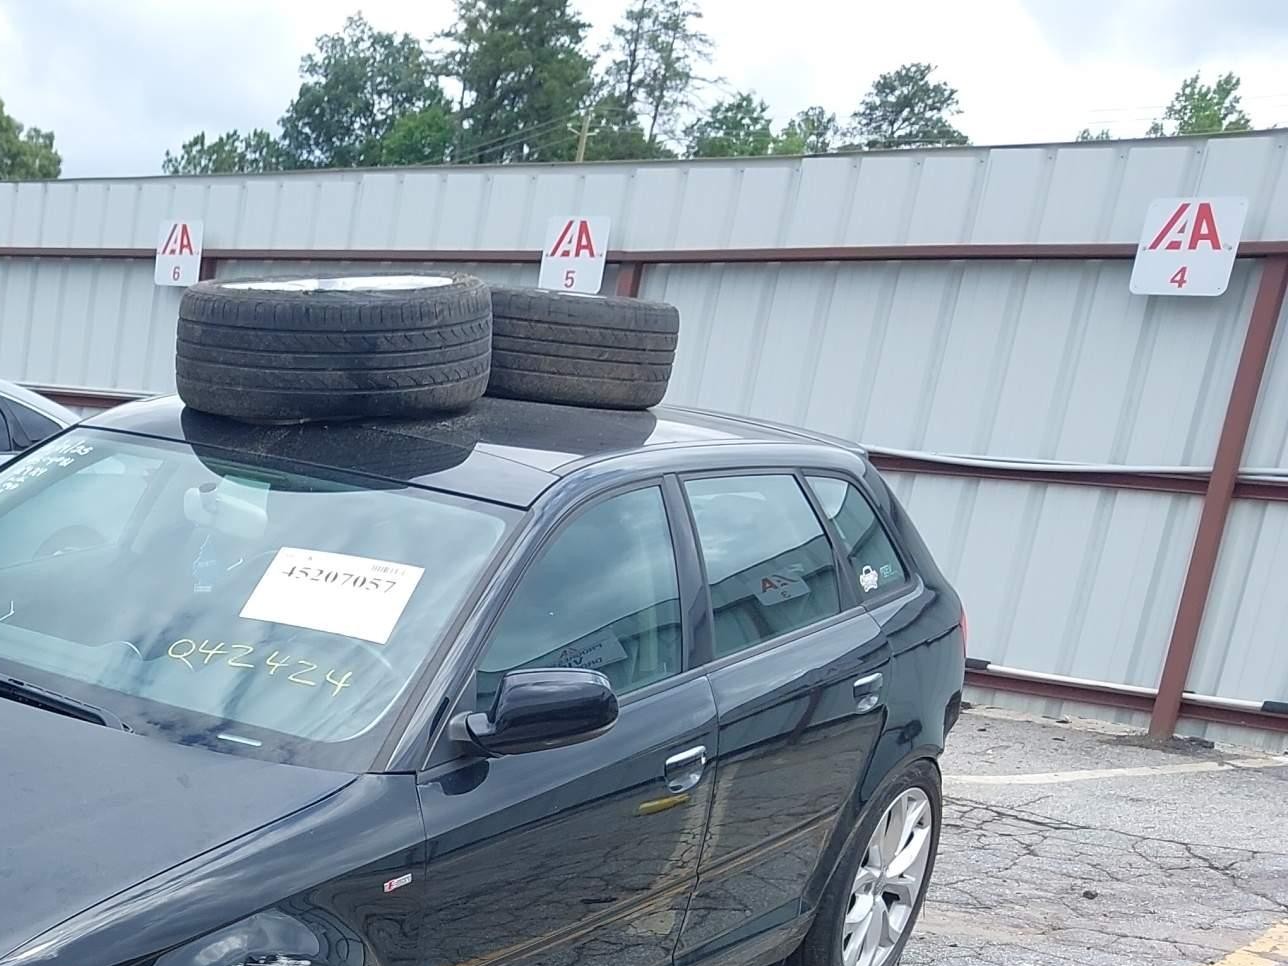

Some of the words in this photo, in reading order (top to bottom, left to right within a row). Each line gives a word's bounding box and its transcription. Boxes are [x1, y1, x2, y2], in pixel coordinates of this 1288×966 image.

[172, 266, 181, 281] 6
[564, 270, 576, 288] 5
[1170, 266, 1188, 288] 4
[281, 565, 397, 593] 45207057
